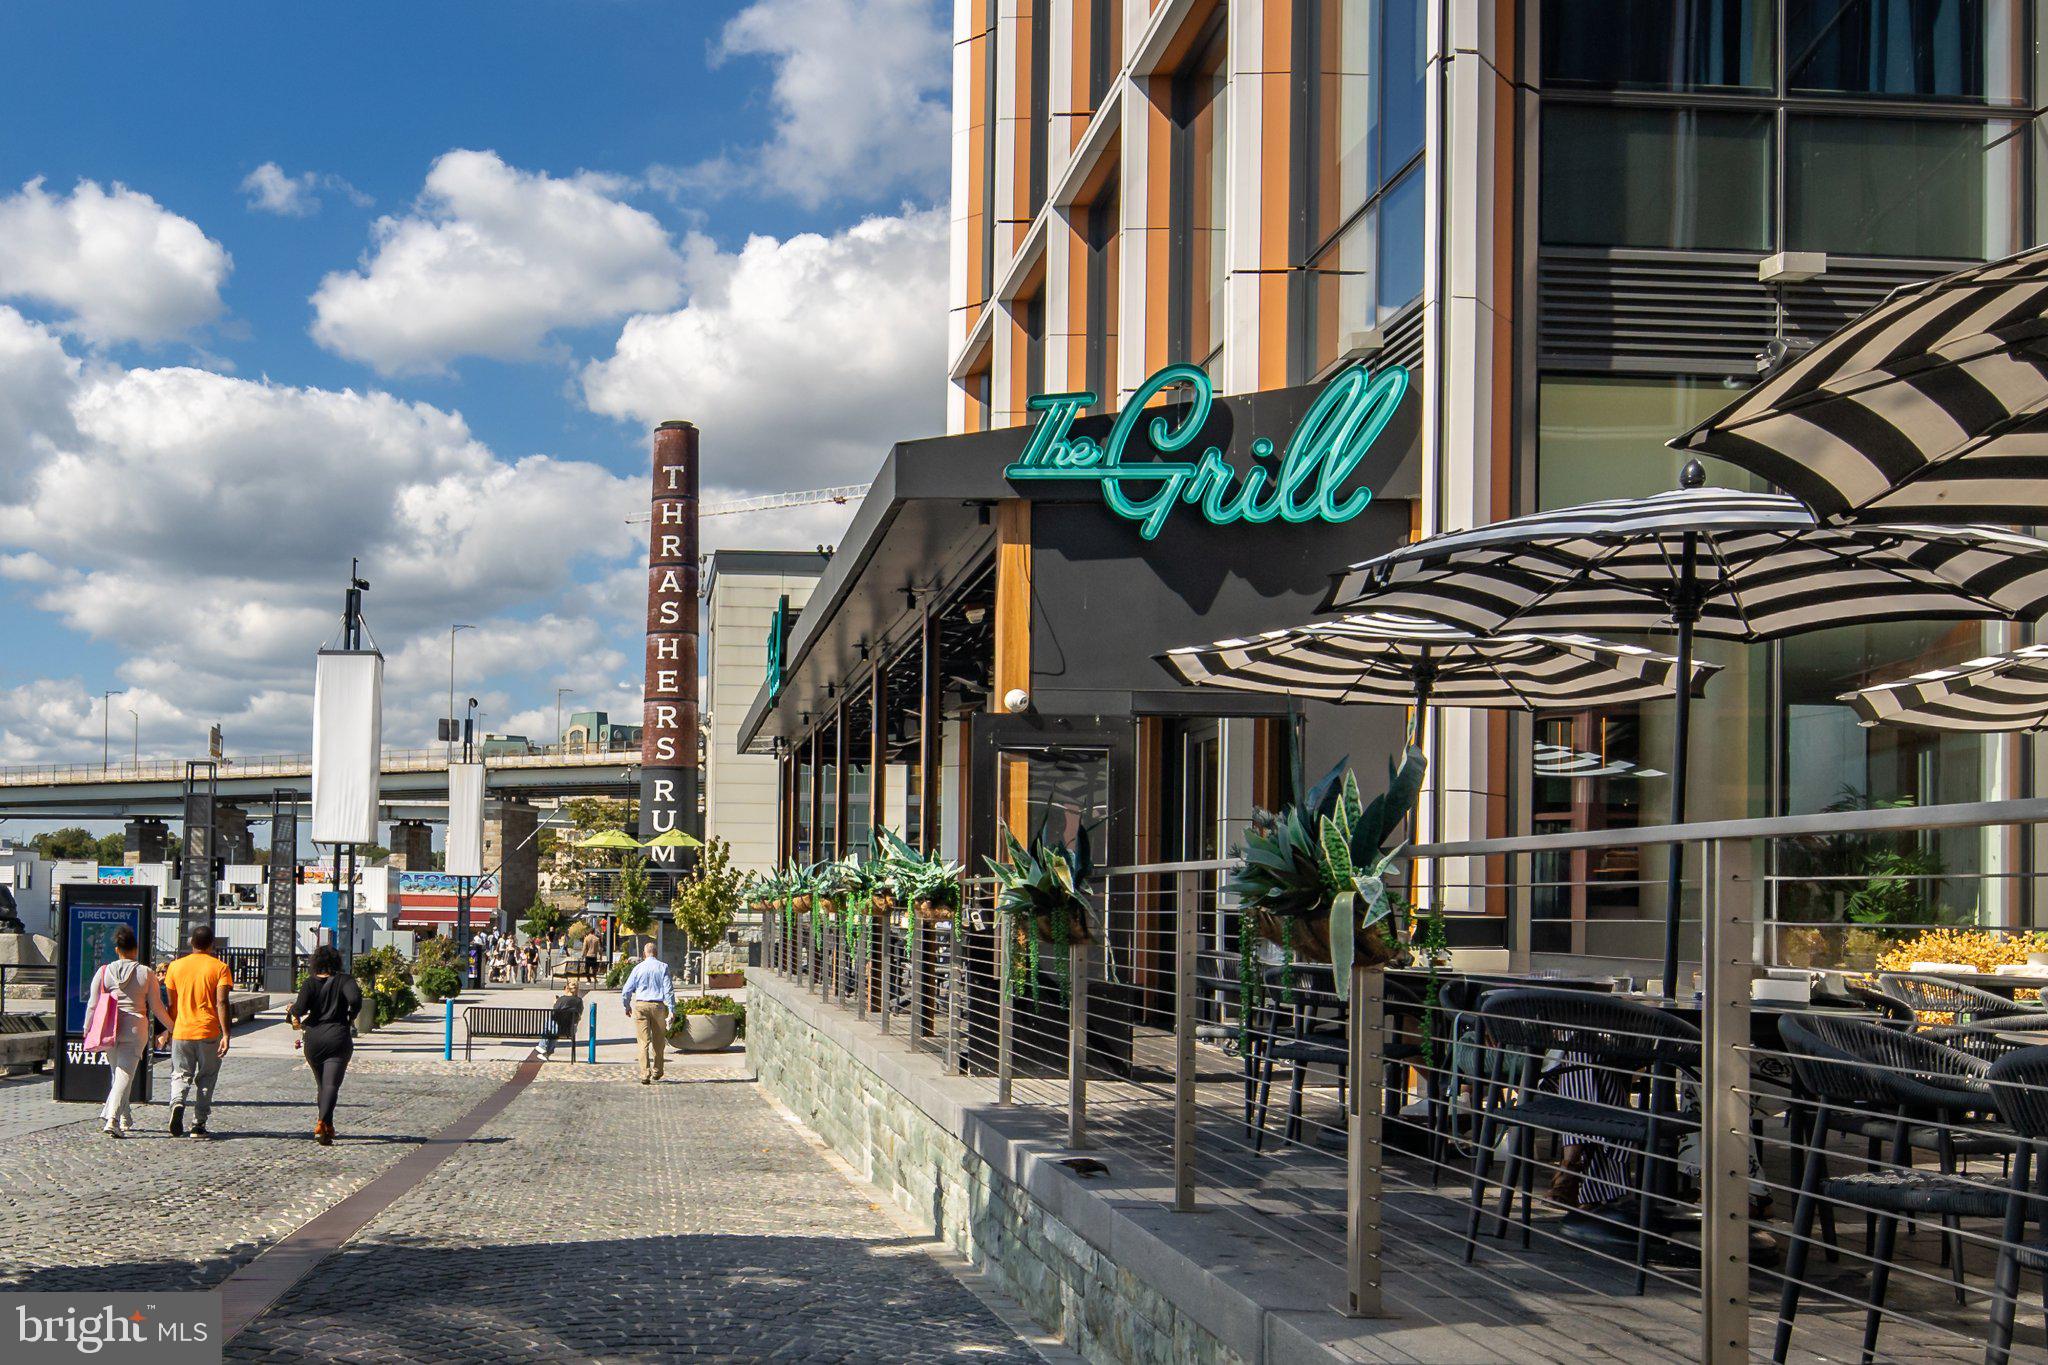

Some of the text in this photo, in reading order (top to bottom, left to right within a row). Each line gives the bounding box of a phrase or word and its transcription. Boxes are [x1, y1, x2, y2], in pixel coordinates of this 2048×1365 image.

[1013, 362, 1409, 541] The Grill
[650, 464, 685, 863] THRASHERS RUM
[77, 910, 132, 920] DIRECTORY
[67, 1042, 85, 1052] TH
[67, 1052, 110, 1065] WHA
